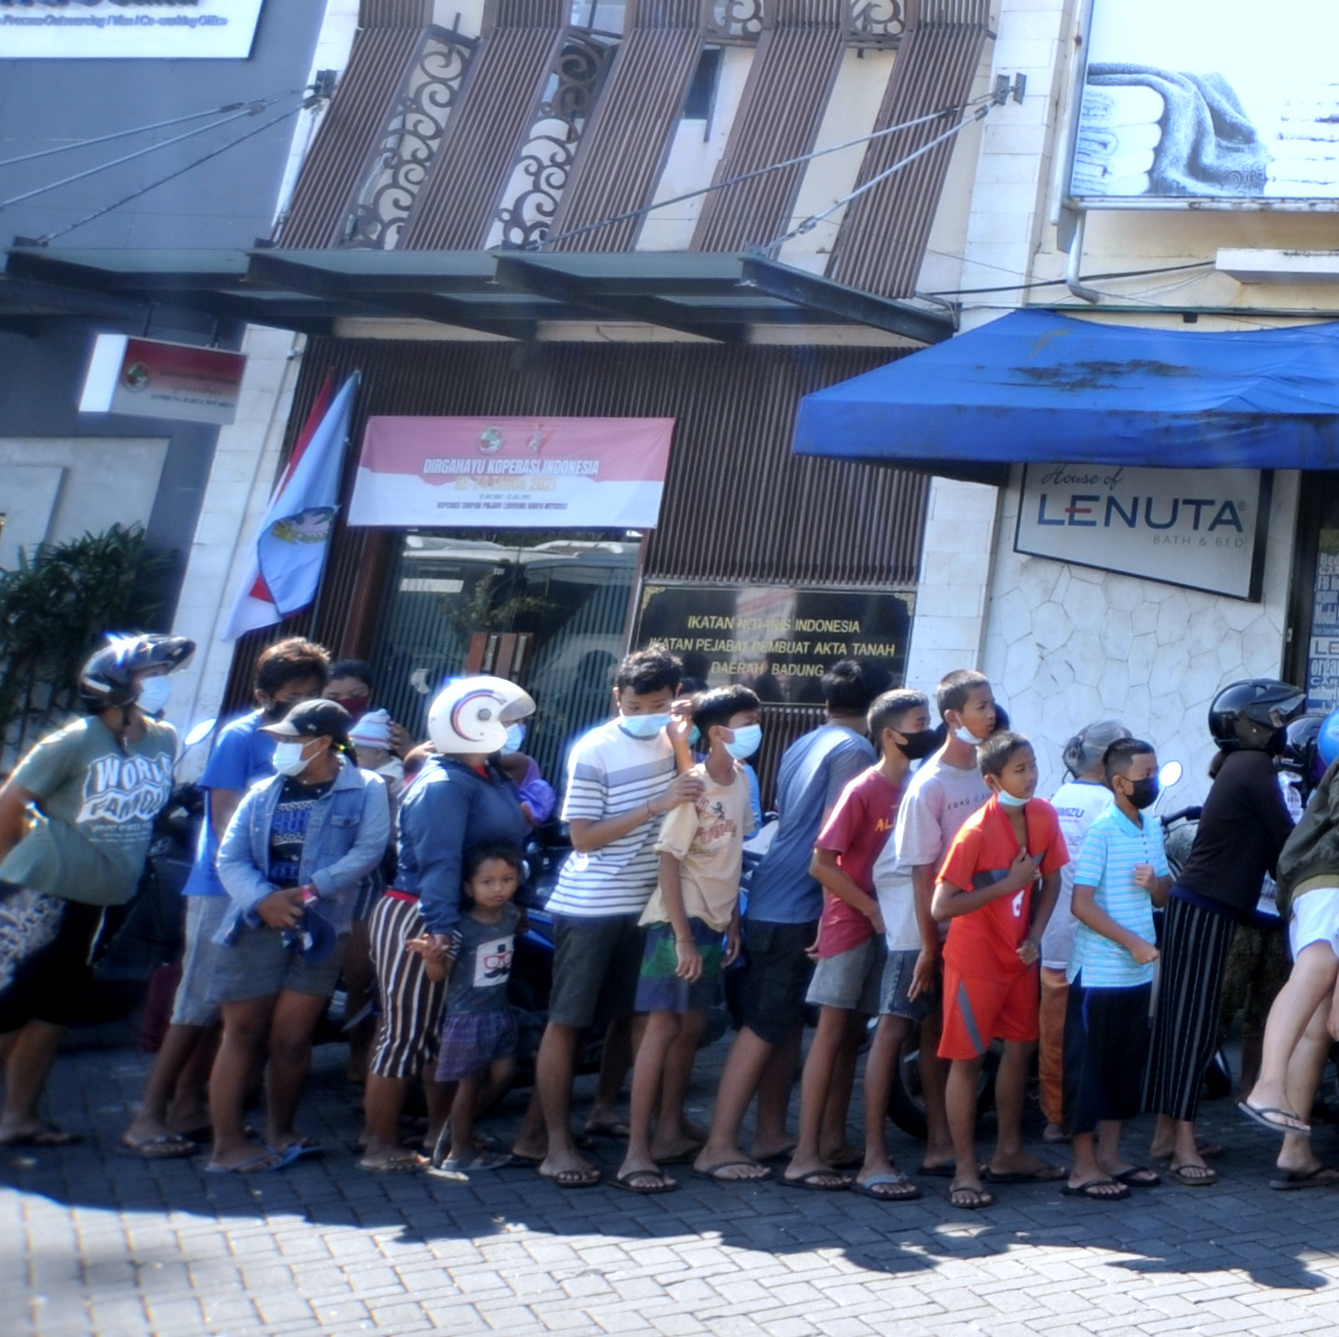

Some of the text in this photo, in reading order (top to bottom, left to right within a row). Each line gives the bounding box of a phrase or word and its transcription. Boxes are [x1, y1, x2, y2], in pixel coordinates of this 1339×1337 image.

[423, 458, 600, 475] DIRGAHAYU KOPERASI INDONESIA
[1041, 464, 1124, 491] House of
[1037, 494, 1244, 533] LENUTA
[1153, 534, 1191, 546] BATH
[1216, 537, 1244, 549] BED
[687, 616, 734, 630] IKATAN
[794, 619, 861, 633] INDONESIA
[696, 638, 747, 653] PEJABAT
[752, 640, 811, 655] PEMBUAT
[814, 642, 848, 656] AKTA
[852, 643, 896, 657] TANAH
[711, 661, 825, 677] DAERAH BADUNG
